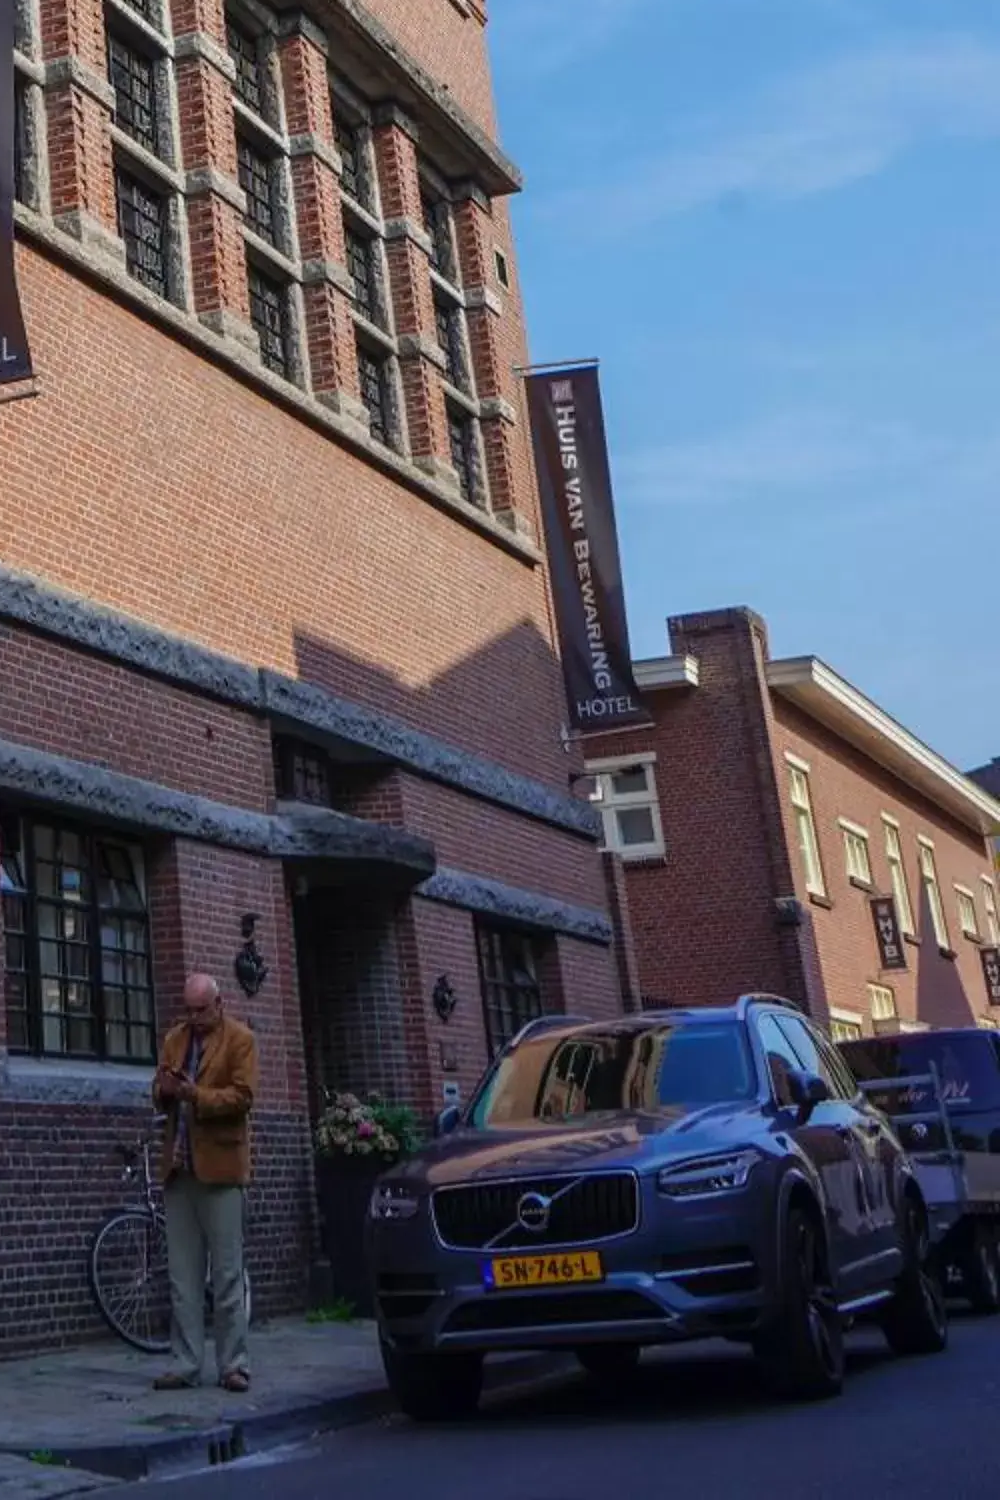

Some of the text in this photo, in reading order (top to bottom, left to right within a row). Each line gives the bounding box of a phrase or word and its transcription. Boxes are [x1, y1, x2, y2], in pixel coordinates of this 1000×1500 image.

[555, 405, 612, 690] HUIS VAN BEWARING
[577, 696, 640, 719] HOTEL
[500, 1256, 594, 1283] SN-746-L
